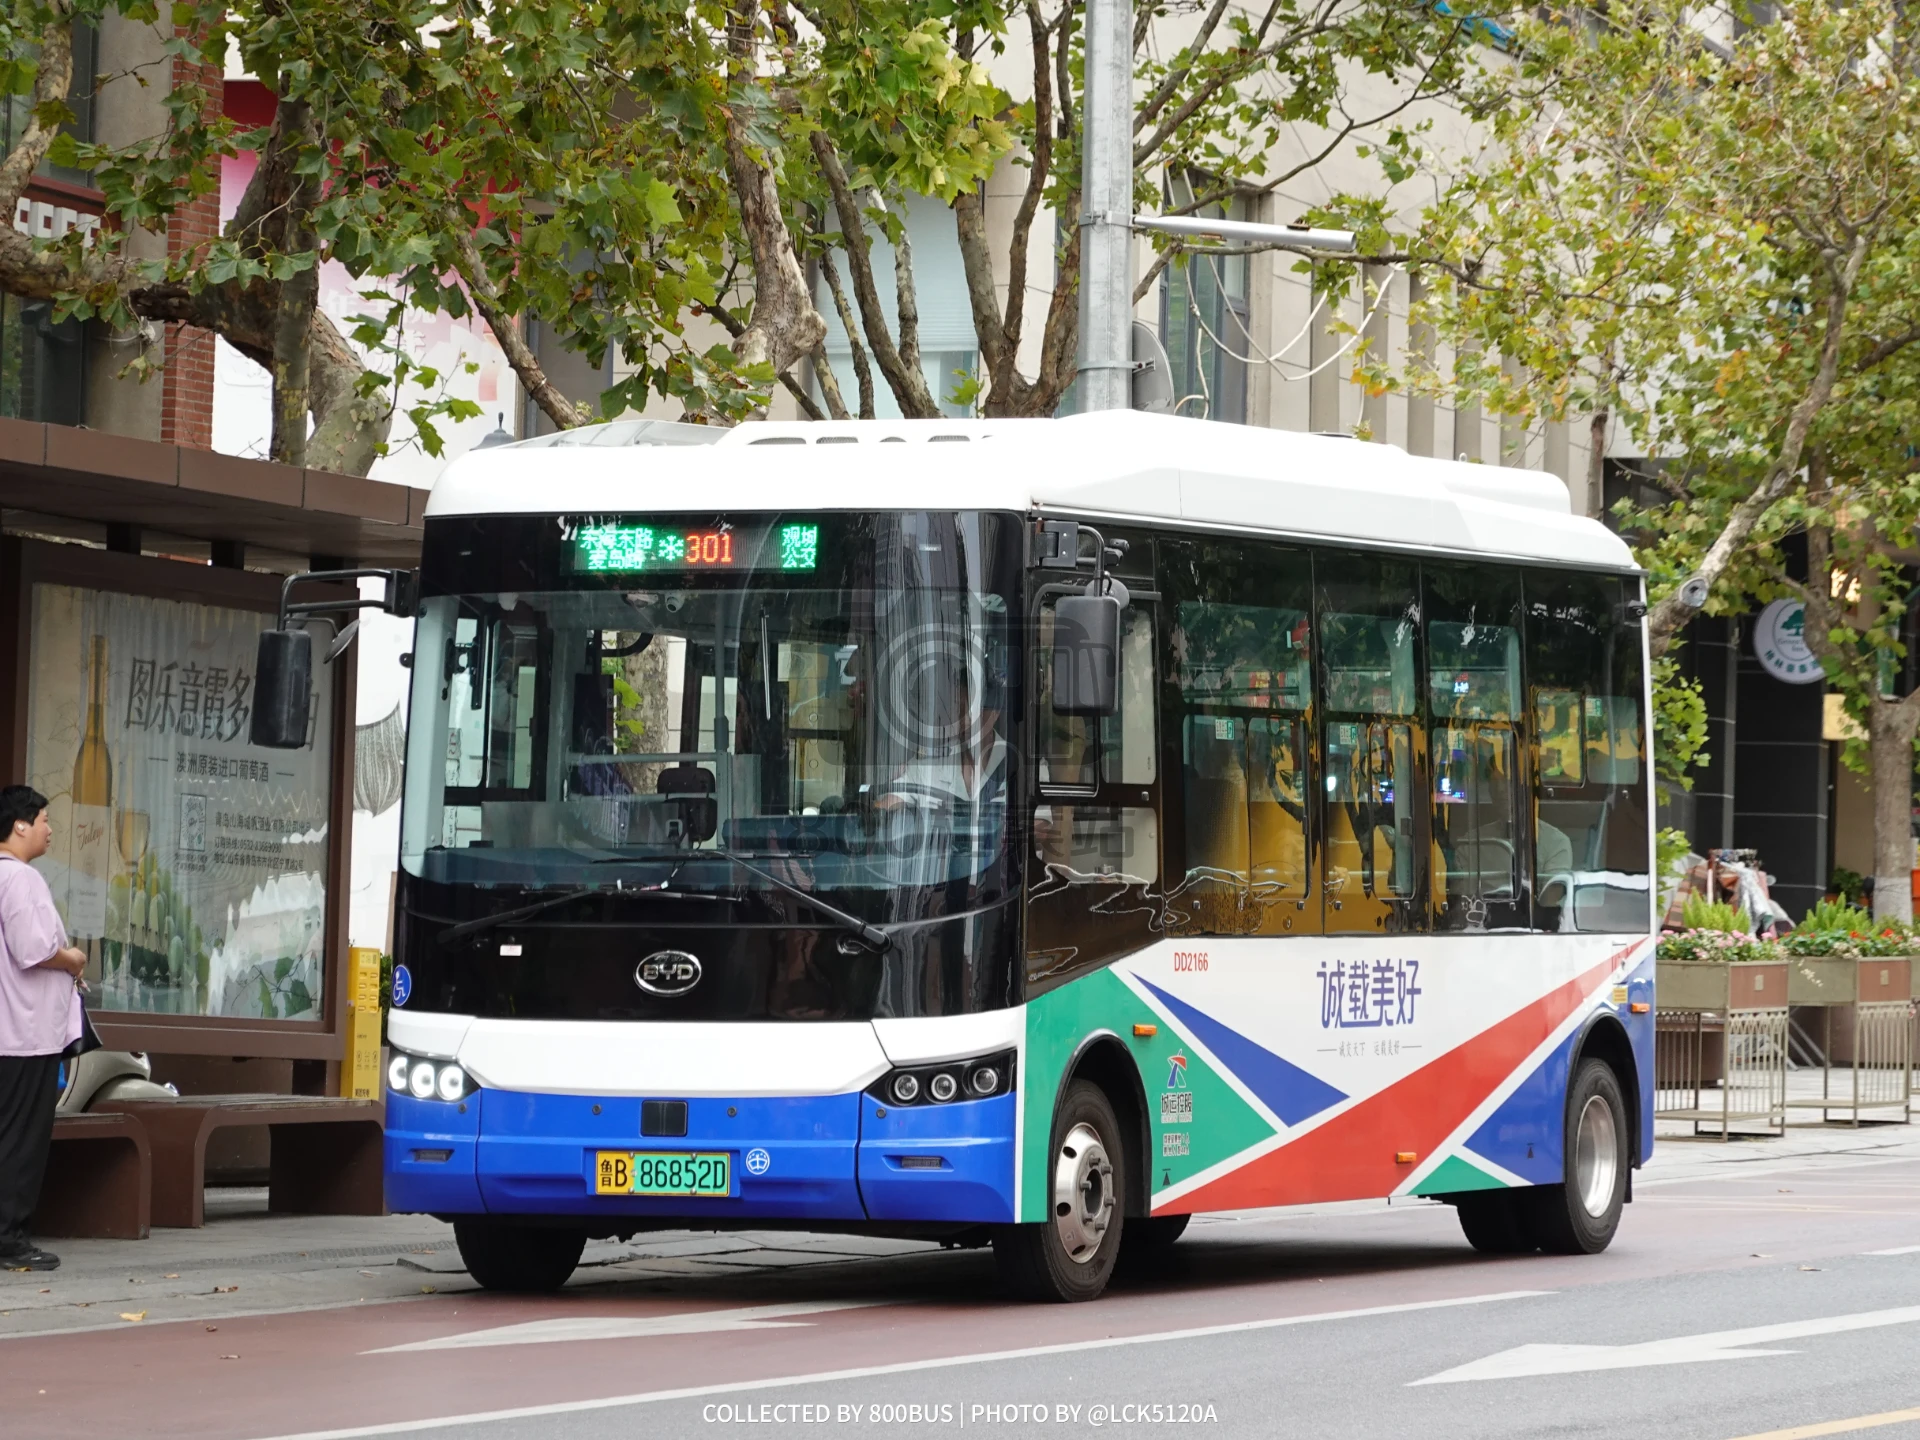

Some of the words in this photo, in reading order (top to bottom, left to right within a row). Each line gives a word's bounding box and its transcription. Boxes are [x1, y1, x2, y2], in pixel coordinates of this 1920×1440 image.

[580, 527, 654, 549] 东海东路
[686, 535, 732, 563] 301
[588, 548, 643, 569] 麦岛路
[176, 751, 269, 782] 澳洲原装进口葡萄酒
[643, 964, 694, 981] BYD
[1174, 952, 1209, 972] DD2166
[1316, 958, 1422, 1029] 诚载美好
